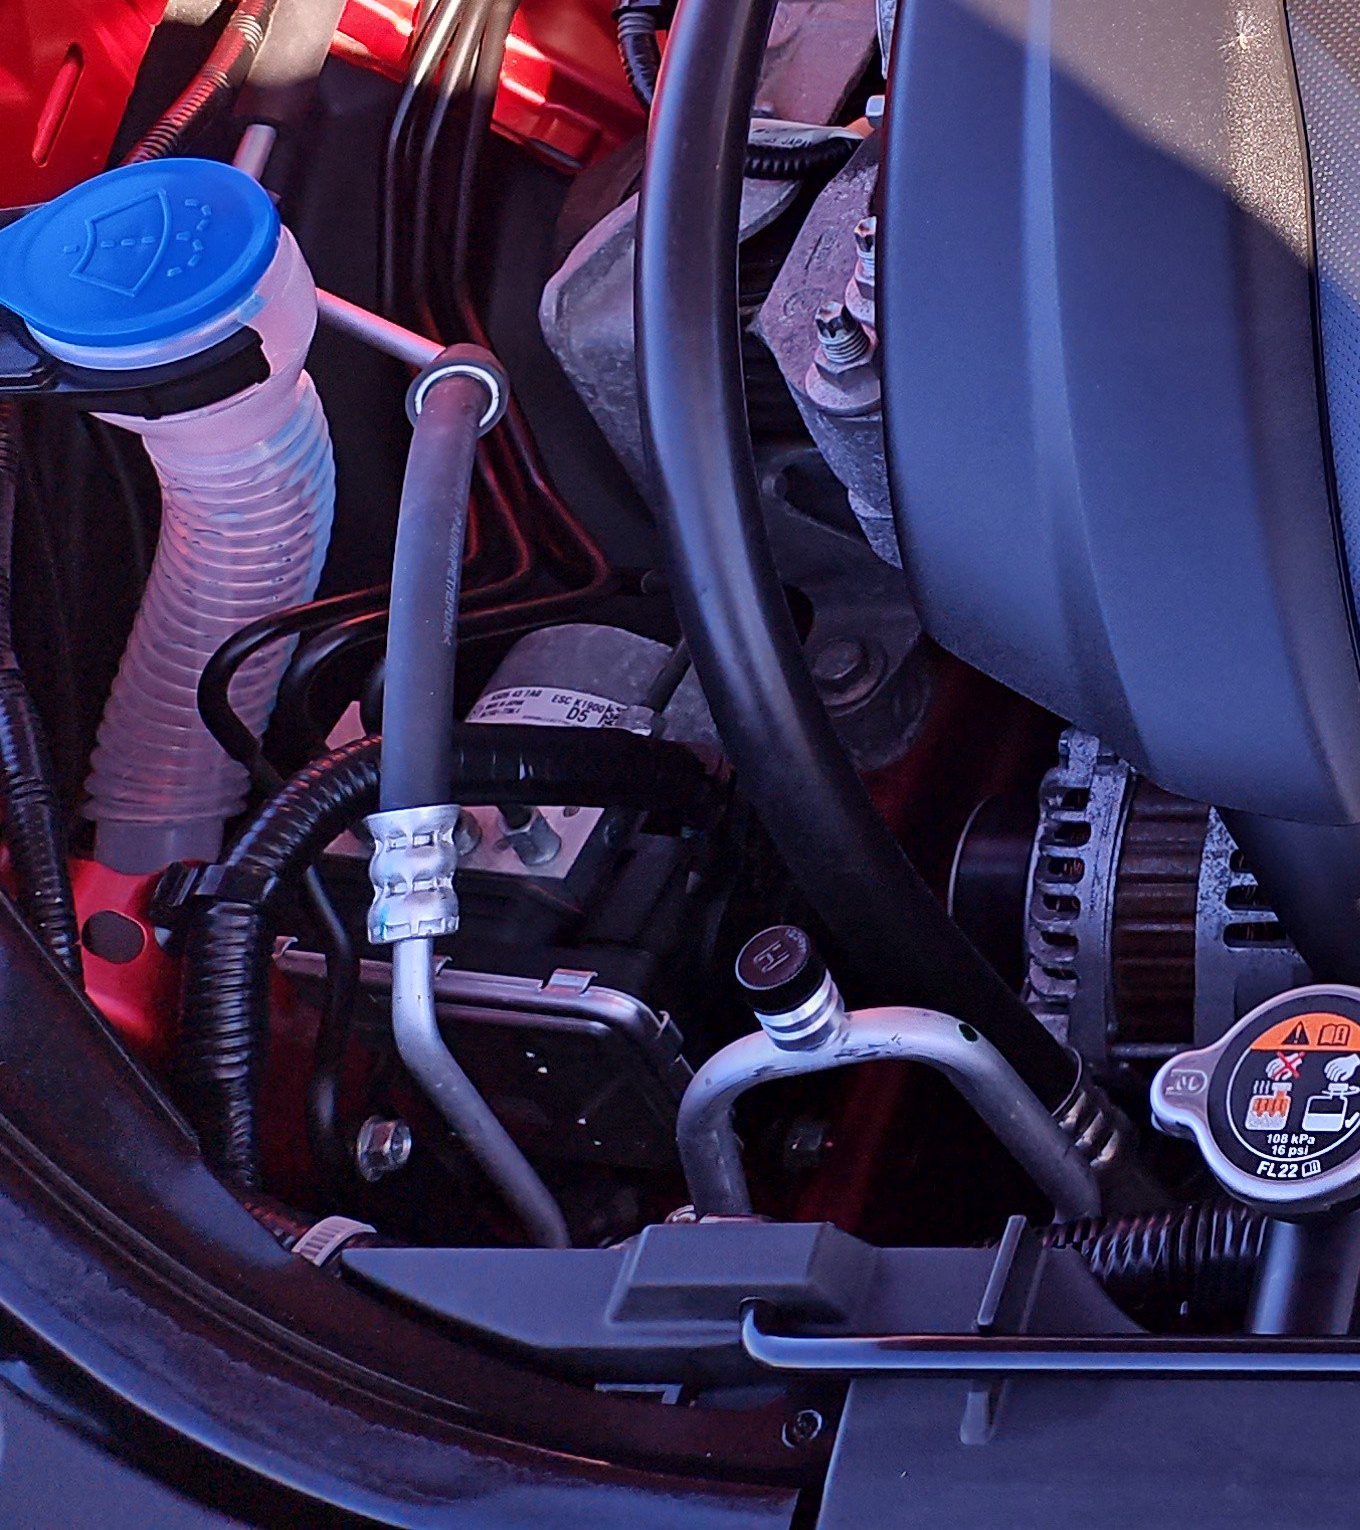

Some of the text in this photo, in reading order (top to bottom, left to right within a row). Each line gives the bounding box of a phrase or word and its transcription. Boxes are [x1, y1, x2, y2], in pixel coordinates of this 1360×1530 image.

[551, 694, 572, 705] ESC
[566, 707, 591, 723] D5
[1266, 1133, 1316, 1145] 108 kPa
[1271, 1144, 1309, 1158] 16 psi
[1256, 1160, 1299, 1178] FL22
